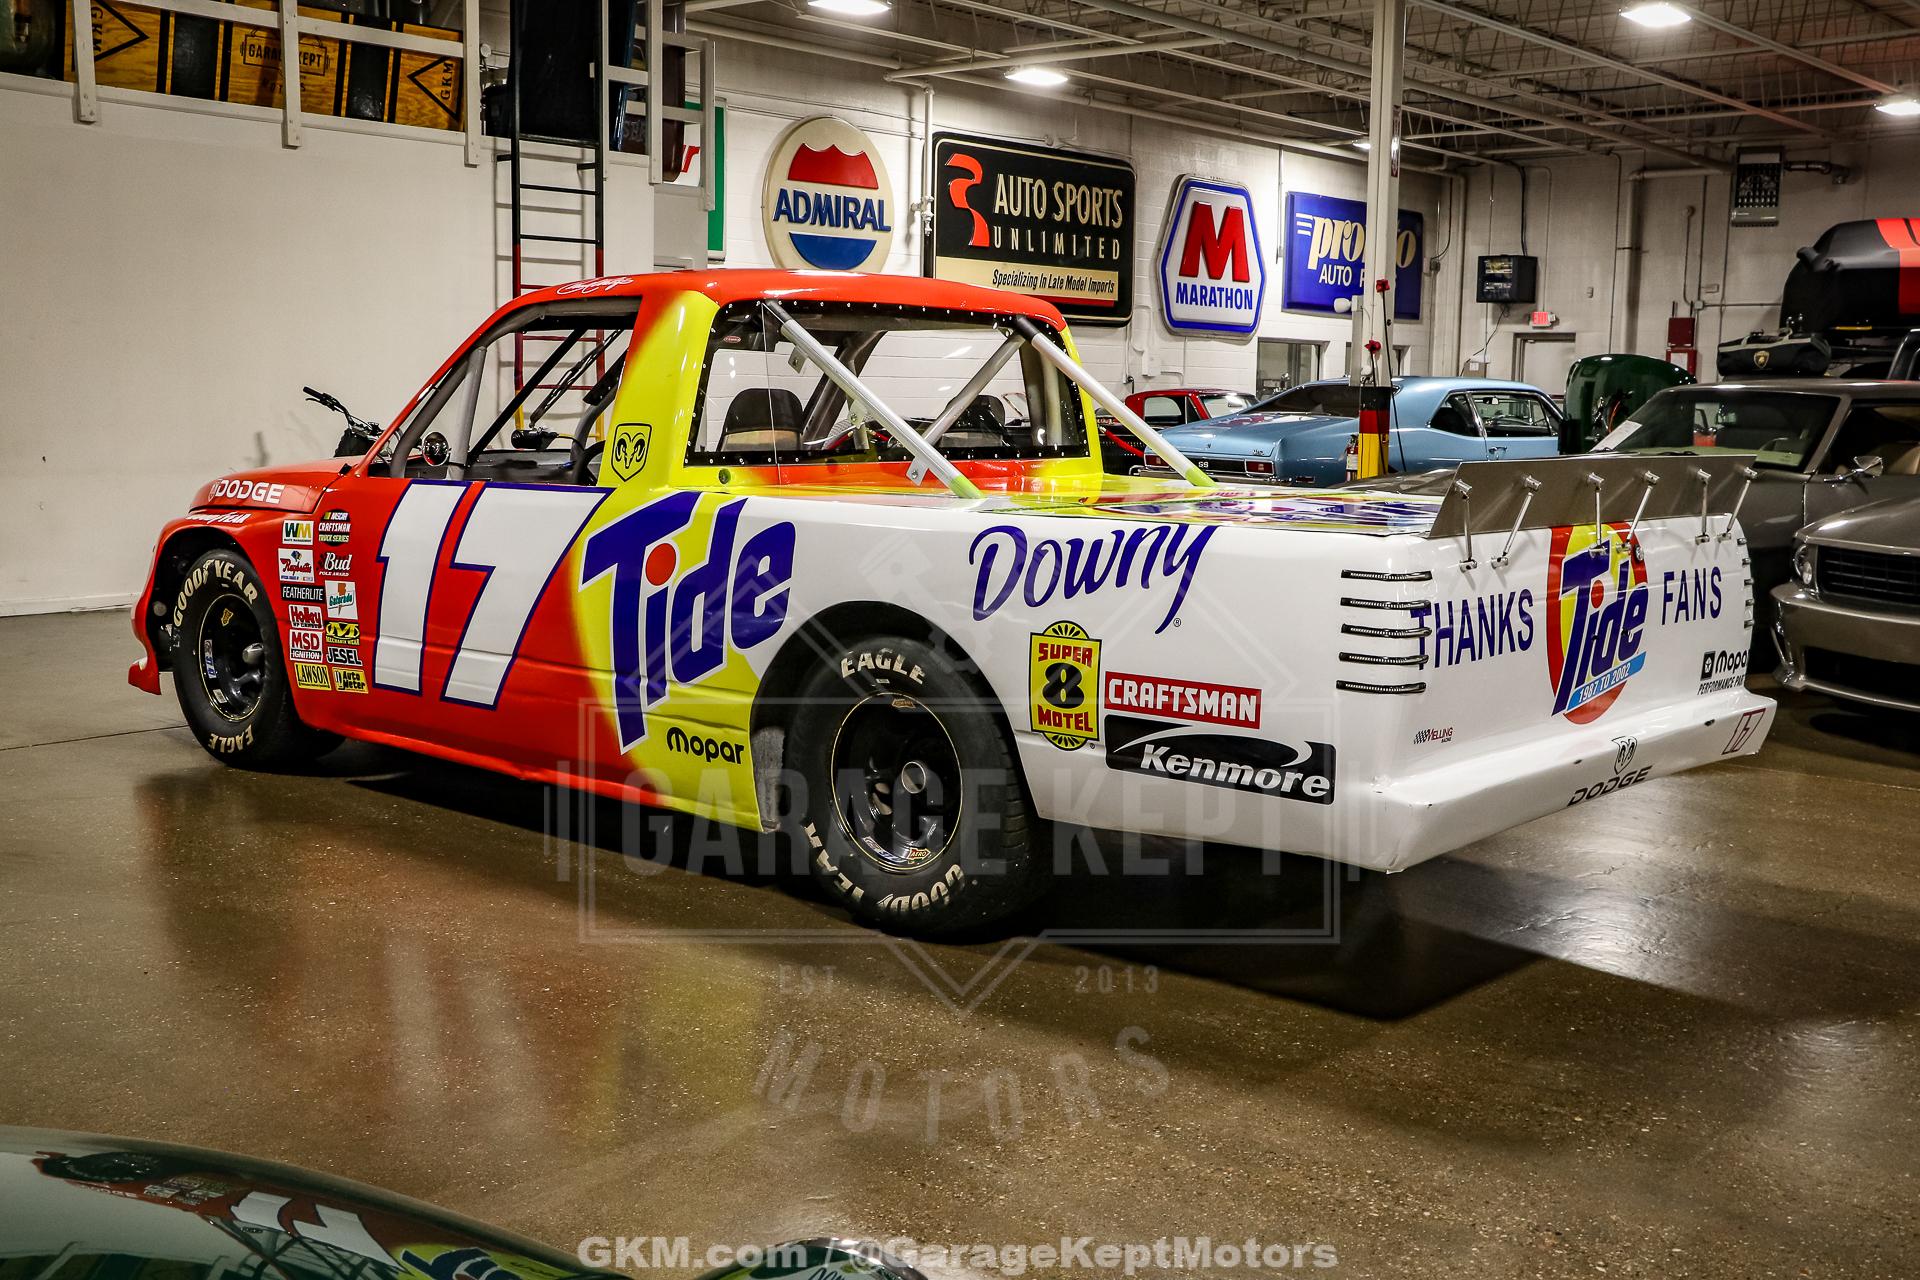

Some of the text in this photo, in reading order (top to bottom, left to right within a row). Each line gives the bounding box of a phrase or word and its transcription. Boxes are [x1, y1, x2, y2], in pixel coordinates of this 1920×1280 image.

[248, 43, 283, 62] GARA
[441, 62, 454, 99] GKM
[773, 188, 891, 231] ADMIRAL
[994, 173, 1122, 229] AUTO SPORTS
[993, 226, 1120, 260] UNLIMITED
[1179, 201, 1250, 283] M
[1308, 216, 1416, 270] proo
[993, 269, 1115, 294] Specializing In Late Model Imports
[1318, 264, 1352, 286] AUTO
[1176, 282, 1253, 310] MARATHON
[215, 479, 285, 504] DODGE
[285, 522, 311, 538] WM
[318, 522, 351, 533] CRAFTSMAN
[324, 552, 352, 571] Bud
[282, 586, 323, 600] FEATHERLITE
[969, 523, 1222, 635] Downy
[373, 478, 617, 711] 17
[1662, 566, 1722, 625] FANS
[578, 490, 797, 756] Tide
[1410, 588, 1534, 671] THANKS
[1551, 539, 1650, 717] Tide
[291, 631, 320, 650] MSD
[292, 650, 320, 659] IGNITION
[327, 647, 362, 665] JESEL
[841, 647, 926, 685] EAGLE
[1038, 643, 1093, 668] SUPER
[1715, 650, 1749, 674] Mopa
[296, 664, 329, 686] LAWSON
[341, 679, 365, 690] Meter
[343, 671, 360, 681] Auto
[1042, 662, 1085, 709] 8
[1578, 663, 1631, 703] 1987 TO 2002
[1697, 676, 1735, 695] PERFORMANCE
[1108, 678, 1258, 722] CRAFTSMAN
[1038, 705, 1094, 733] MOTEL
[208, 724, 254, 754] EAGLE
[1140, 743, 1331, 798] Kenmore
[1567, 765, 1653, 807] DODGE
